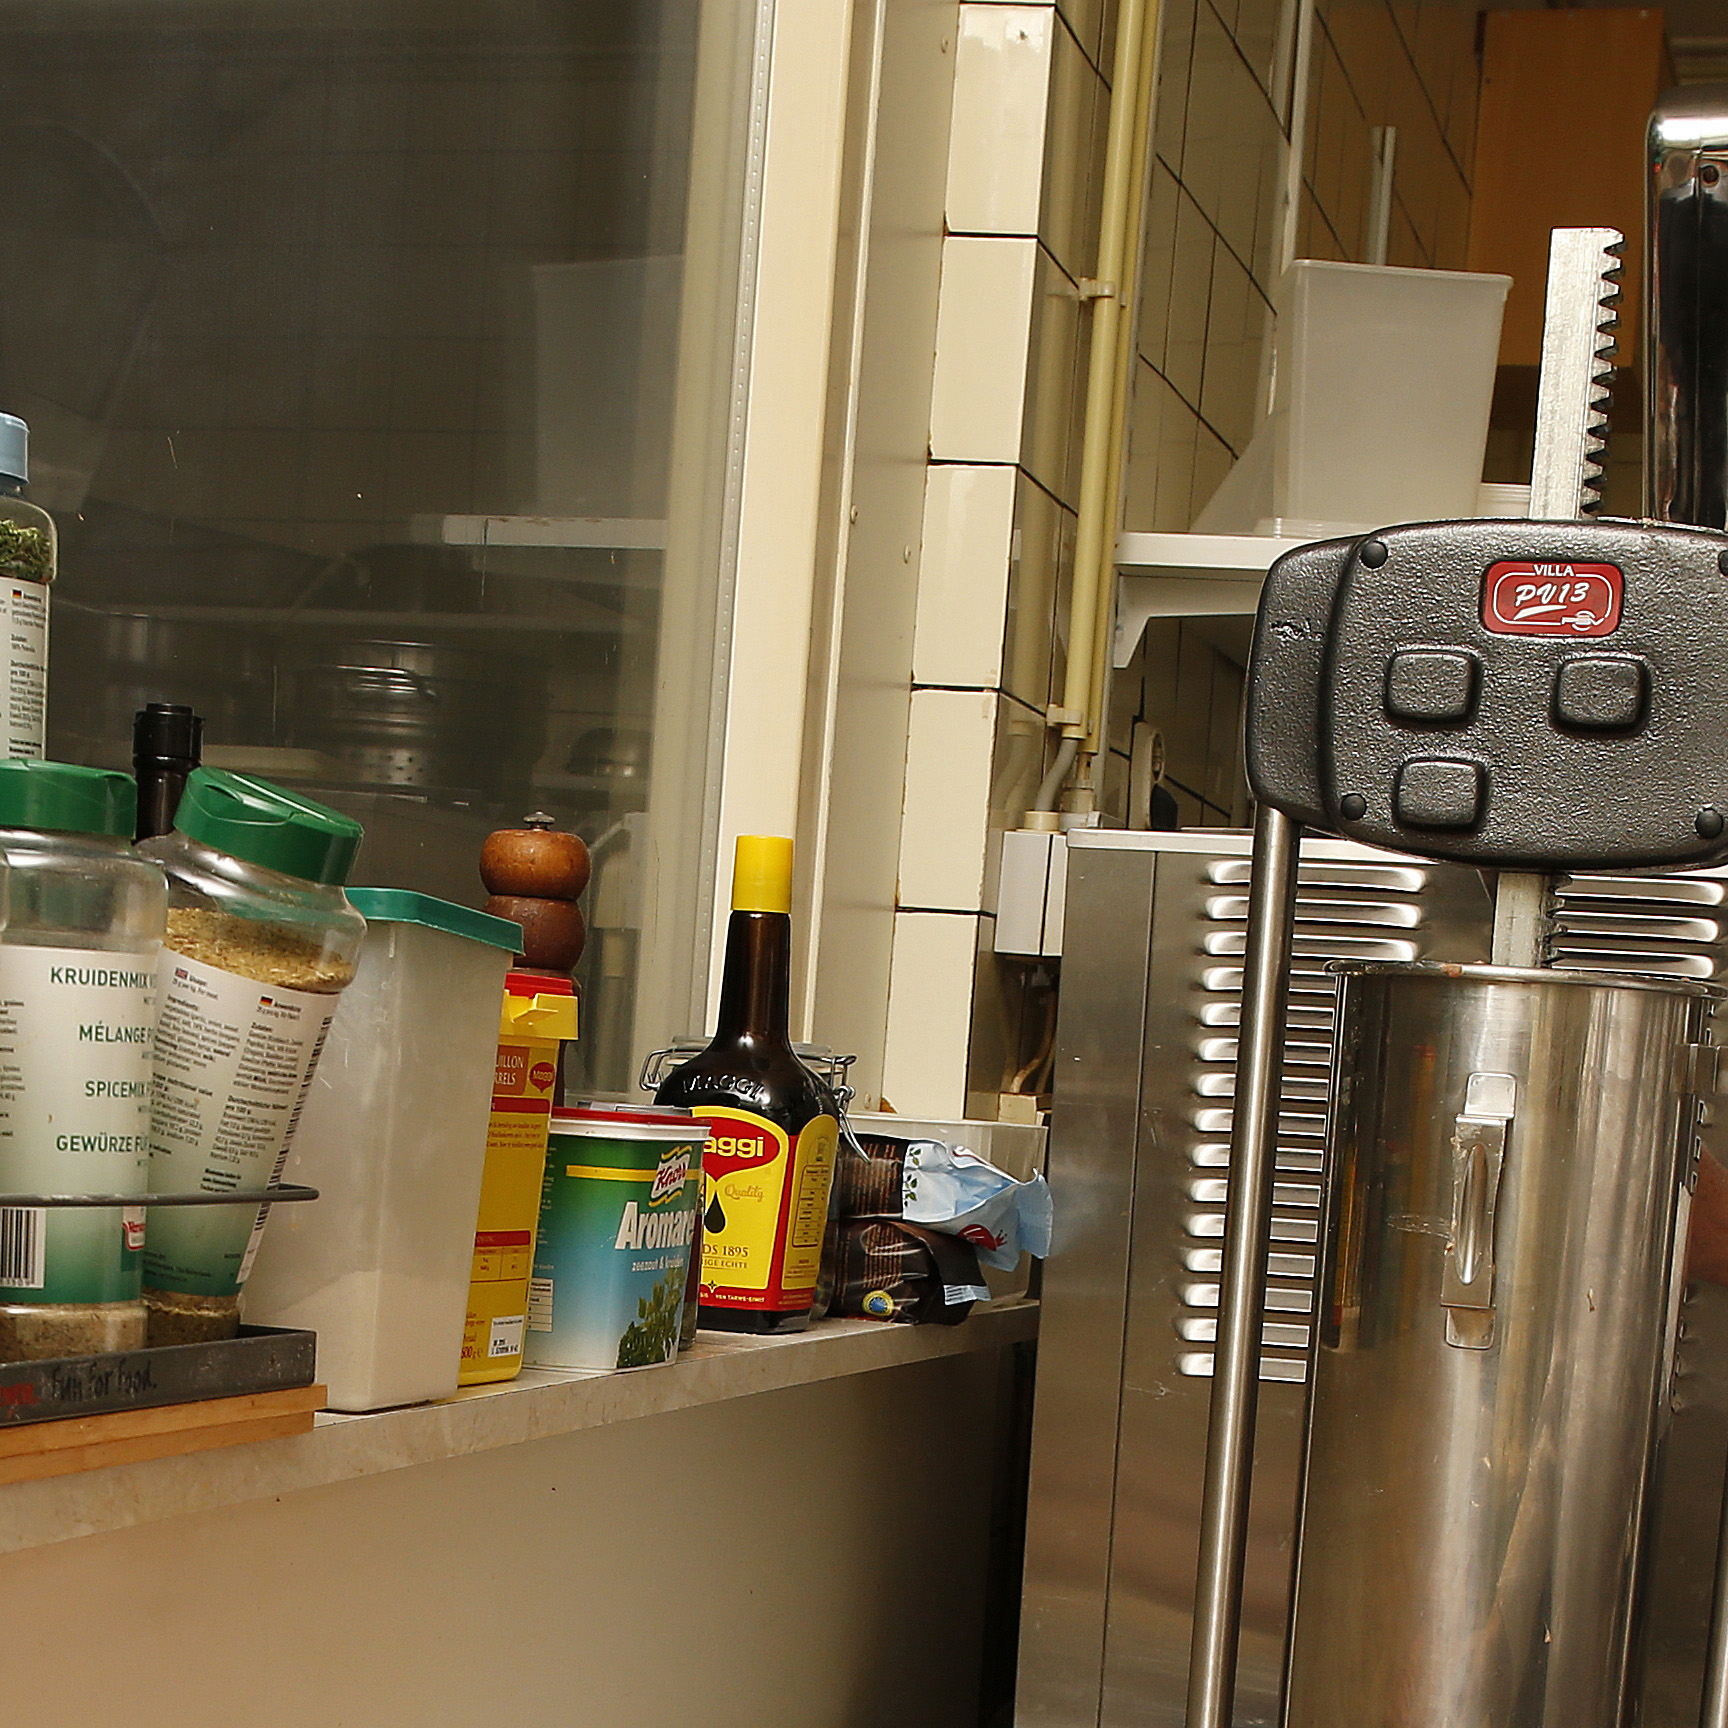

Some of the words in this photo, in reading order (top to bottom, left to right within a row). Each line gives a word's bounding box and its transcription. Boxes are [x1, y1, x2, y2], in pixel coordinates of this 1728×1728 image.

[1533, 563, 1576, 578] VILLA
[1513, 580, 1592, 609] PV13
[50, 965, 149, 989] KRUIDENMIX
[78, 1019, 146, 1044] MÉLANGE
[494, 1055, 524, 1069] UILLON
[55, 1131, 133, 1153] GEWÜRZE
[703, 1135, 765, 1159] aggi
[655, 1161, 687, 1192] Knorr
[702, 1244, 719, 1256] DS
[722, 1245, 750, 1258] 1895
[50, 1364, 83, 1402] Fun
[88, 1360, 114, 1399] For
